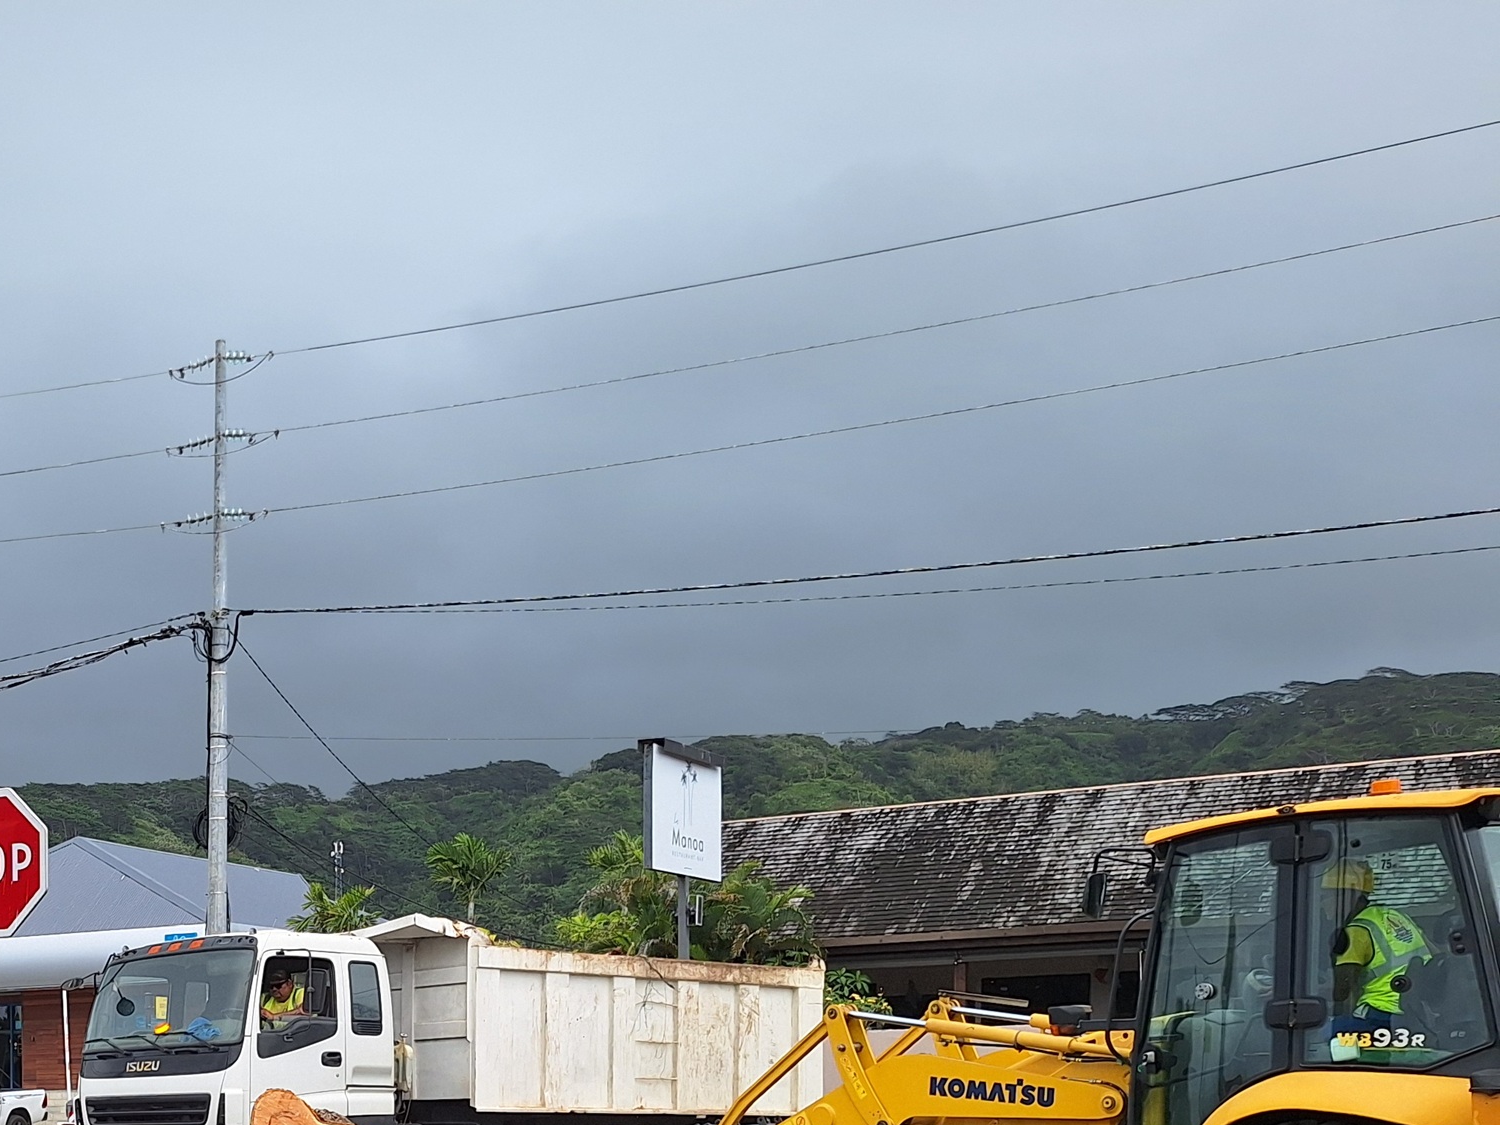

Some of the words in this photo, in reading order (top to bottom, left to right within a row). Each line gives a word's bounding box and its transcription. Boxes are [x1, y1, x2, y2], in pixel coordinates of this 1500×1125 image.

[671, 827, 704, 853] Manoa
[1336, 1028, 1426, 1048] WB93R
[126, 1061, 160, 1072] ISUZU
[929, 1076, 1055, 1108] KOMATSU
